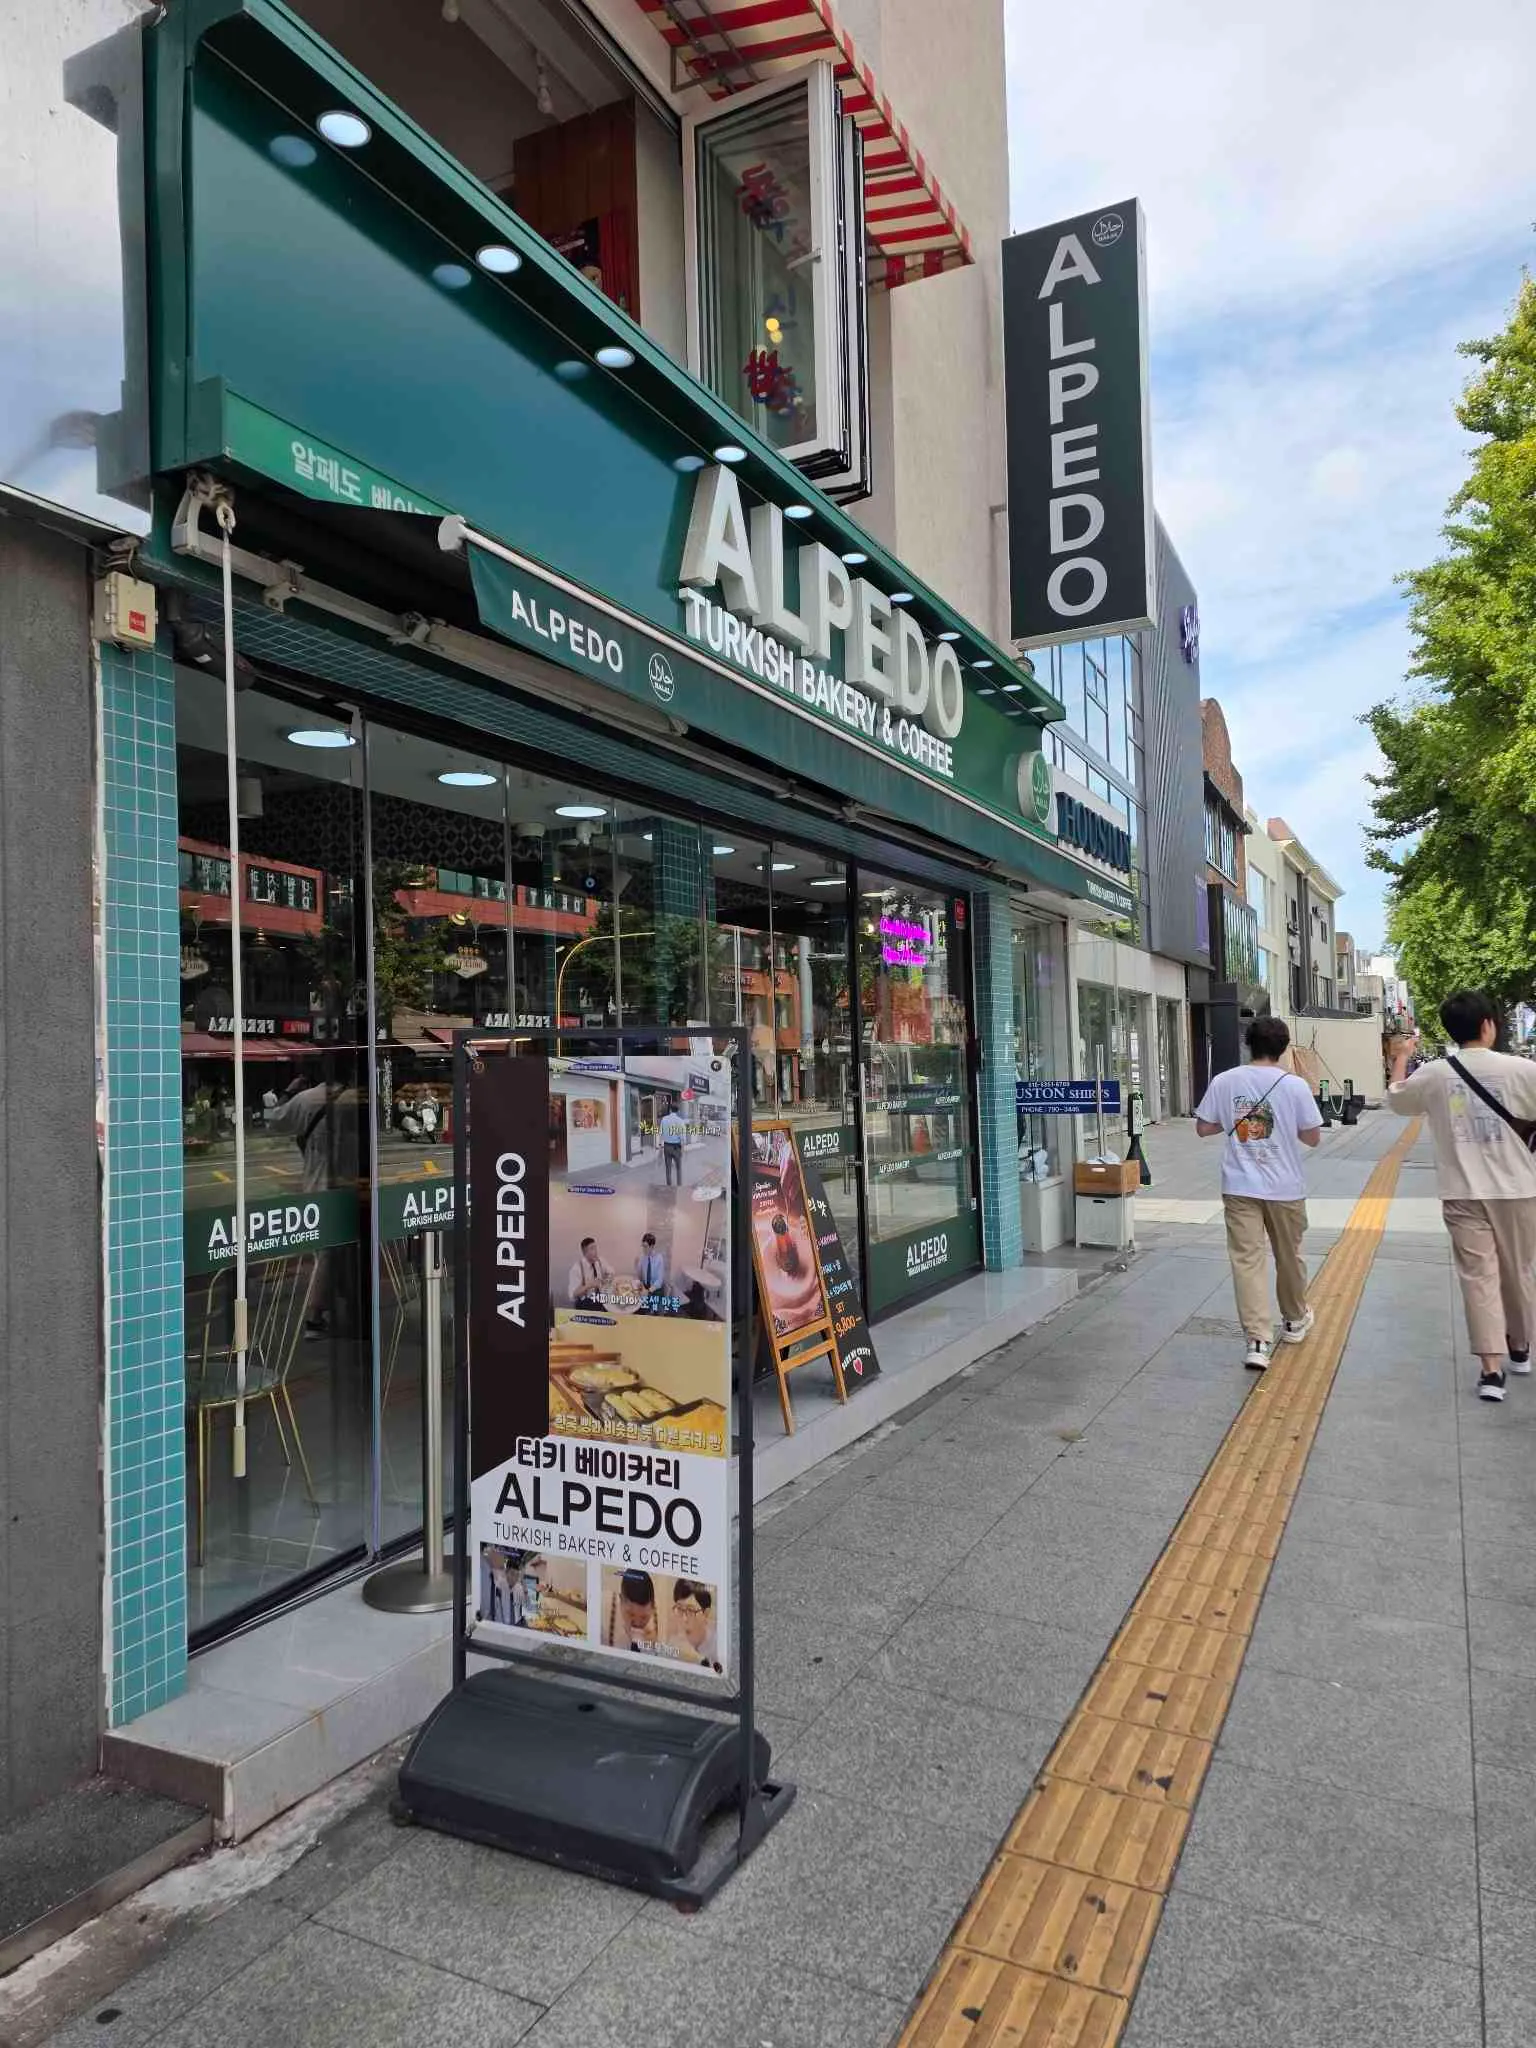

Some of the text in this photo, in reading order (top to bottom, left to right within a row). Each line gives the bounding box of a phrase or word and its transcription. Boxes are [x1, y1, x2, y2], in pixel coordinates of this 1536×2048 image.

[1037, 232, 1109, 618] ALPEDO
[291, 441, 363, 503] 알페도
[680, 463, 965, 739] ALPEDO
[511, 589, 623, 673] ALPEDO
[679, 587, 954, 778] TURKISH BAKERY & COFFEE
[804, 1132, 840, 1151] ALPEDO
[208, 1203, 320, 1248] ALPEDO
[247, 1238, 280, 1253] BAKERY
[282, 1235, 289, 1246] &
[290, 1230, 320, 1243] COFFEE
[403, 1214, 432, 1229] TURKISH
[495, 1152, 528, 1328] ALPEDO
[906, 1233, 948, 1268] ALPEDO
[517, 1438, 680, 1490] 터키 베이커리
[494, 1472, 702, 1547] ALPEDO
[494, 1521, 699, 1576] TURKISH BAKERY & COFFEE
